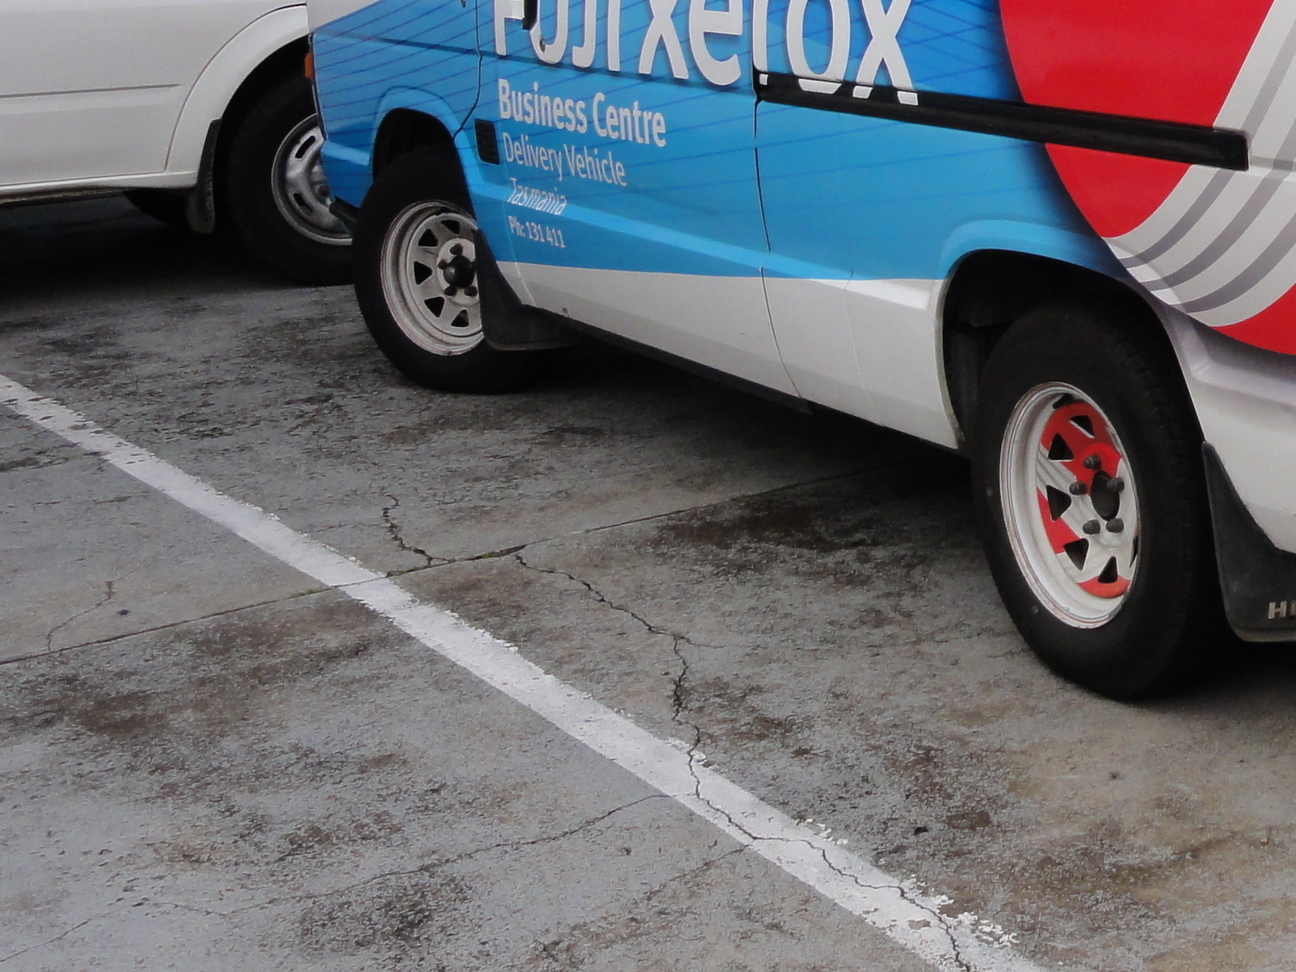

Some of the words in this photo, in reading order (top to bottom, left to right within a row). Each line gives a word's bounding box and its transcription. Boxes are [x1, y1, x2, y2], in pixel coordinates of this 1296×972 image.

[498, 78, 588, 133] Business
[592, 92, 667, 147] Centre
[502, 132, 563, 181] Delivery
[563, 143, 627, 187] Vehicle
[507, 177, 568, 215] Tasmania
[508, 215, 525, 238] Ph:
[525, 221, 545, 243] 131
[546, 226, 566, 248] 411
